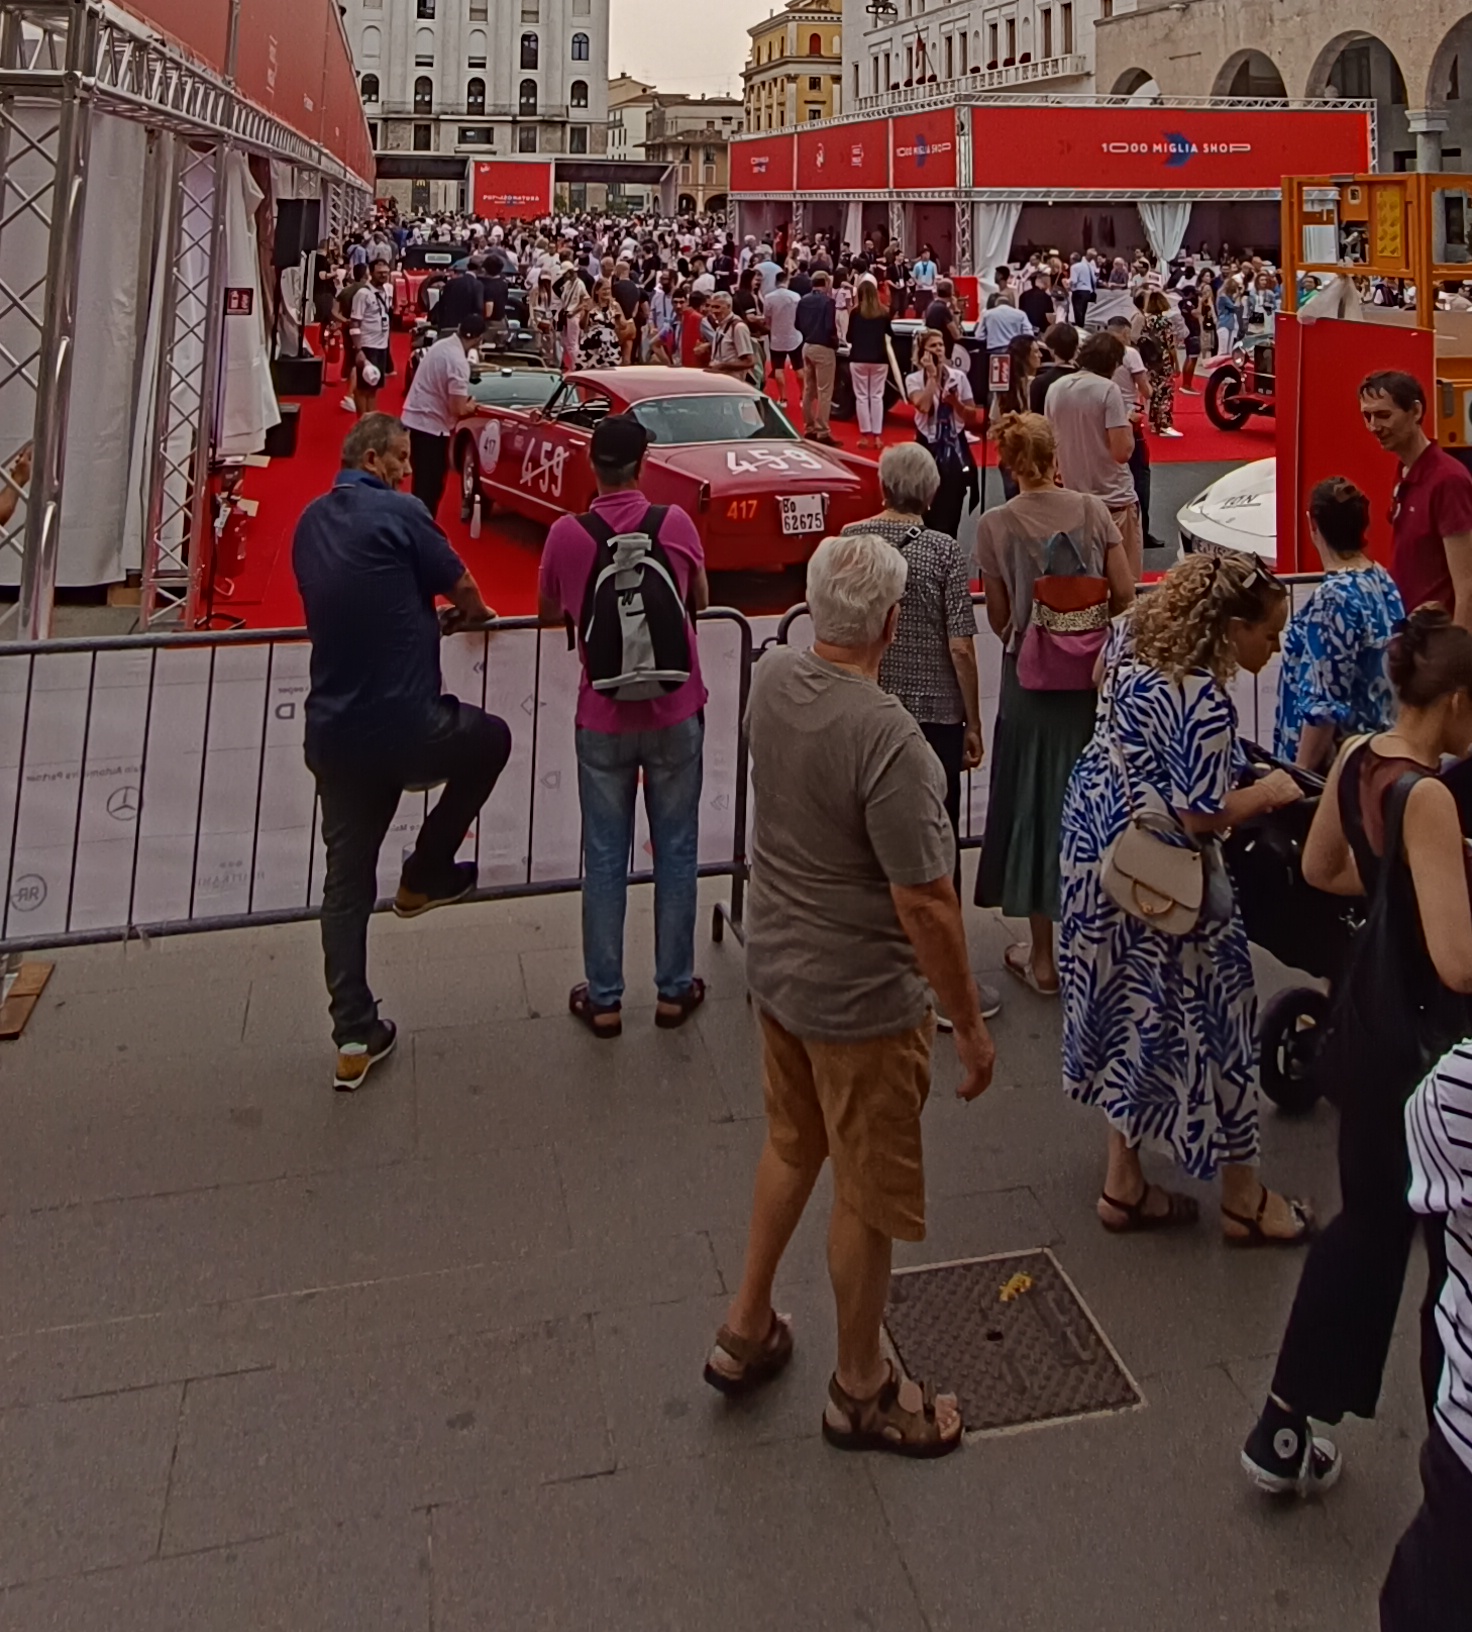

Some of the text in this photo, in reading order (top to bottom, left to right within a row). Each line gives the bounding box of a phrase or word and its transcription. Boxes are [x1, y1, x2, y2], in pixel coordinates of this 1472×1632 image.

[1101, 142, 1251, 153] 1000 MIGLIA SHOP
[484, 436, 496, 455] 417
[520, 437, 569, 497] 459
[726, 449, 822, 475] 459
[727, 500, 758, 519] 417
[784, 513, 822, 531] 62675
